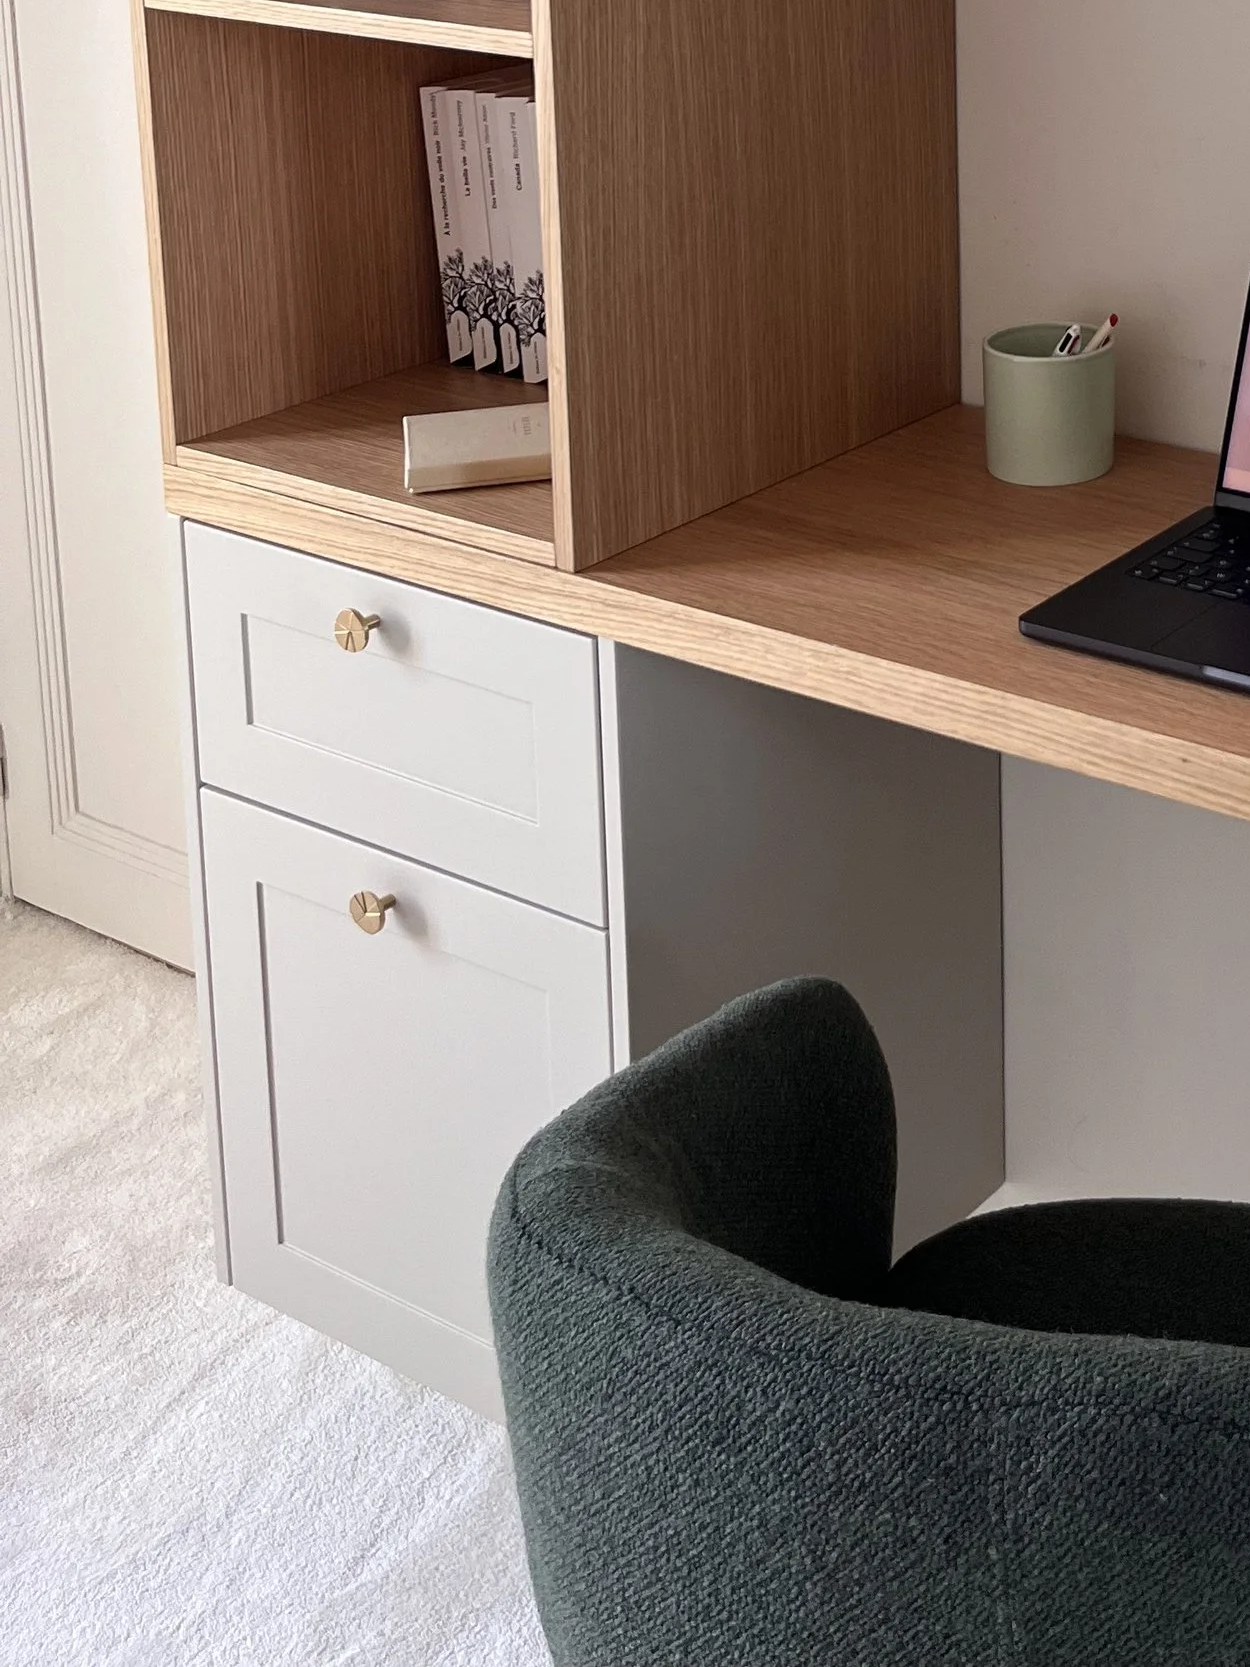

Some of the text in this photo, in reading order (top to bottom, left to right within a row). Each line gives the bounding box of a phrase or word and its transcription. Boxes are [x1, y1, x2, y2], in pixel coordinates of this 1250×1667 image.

[511, 131, 520, 159] Richard
[514, 163, 522, 191] Canada
[465, 187, 471, 197] La
